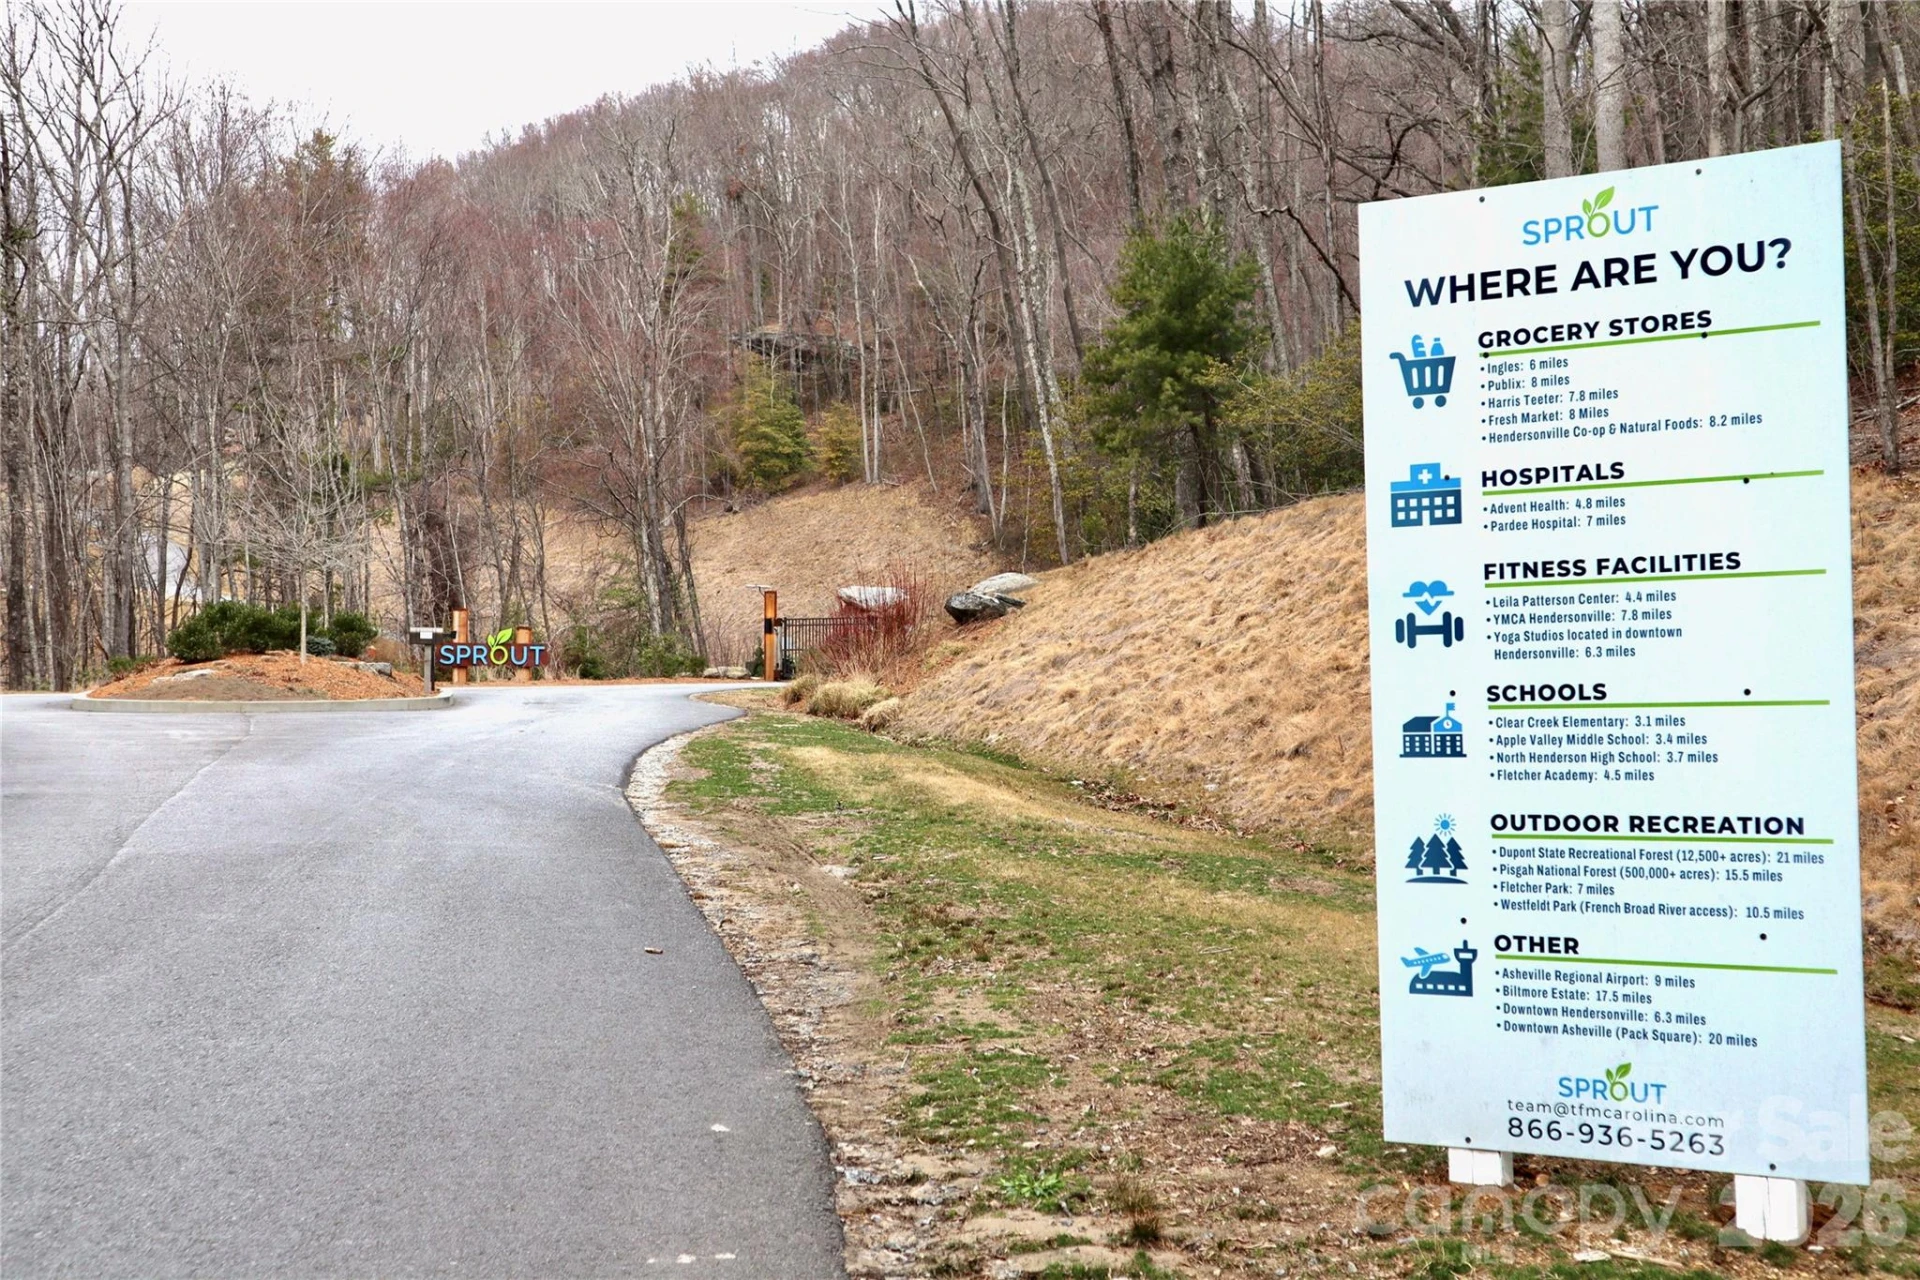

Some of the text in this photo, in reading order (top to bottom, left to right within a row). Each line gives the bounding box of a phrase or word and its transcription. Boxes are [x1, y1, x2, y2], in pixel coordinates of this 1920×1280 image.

[1522, 204, 1659, 246] SPROUT
[1403, 237, 1792, 308] WHERE ARE YOU?
[1477, 309, 1712, 349] GROCERY STORES
[1487, 356, 1569, 376] Ingles: 6 miles
[1487, 374, 1570, 391] Publix: 8 miles
[1487, 387, 1619, 409] Harris Teeter: 7.8 miles
[1488, 406, 1609, 426] Fresh Market: 8 Miles
[1488, 412, 1763, 444] Hendersonville Co-op & Natural Foods: 8.2 miles
[1481, 461, 1625, 488] HOSPITALS
[1489, 495, 1626, 515] Advent Health: 4.8 miles
[1490, 513, 1626, 532] Pardee Hospital: 7 miles
[1483, 551, 1741, 581] FITNESS FACILITIES
[1492, 589, 1677, 608] Leila Patterson Center: 4.4 miles
[1492, 607, 1672, 625] YMCA Hendersonville: 7.8 miles
[1493, 626, 1682, 645] Yoga Studios located in downtown
[440, 644, 545, 666] SPROUT
[1493, 644, 1636, 660] Hendersonville: 6.3 miles
[1486, 682, 1608, 703] SCHOOLS
[1495, 714, 1686, 730] Clear Creek Elementary: 3.1 miles
[1495, 732, 1707, 748] Apple Valley Middle School: 3.4 miles
[1496, 750, 1719, 766] North Henderson High School: 3.7 miles
[1496, 768, 1655, 784] Fletcher Academy: 4.5 miles
[1489, 813, 1805, 836] OUTDOOR RECREATION
[1499, 846, 1824, 865] Dupont State Recreational Forest (12,500+ acres): 21 miles
[1499, 863, 1783, 883] Pisgah National Forest (500,000+ acres): 15.5 miles
[1500, 880, 1615, 896] Fletcher Park: 7 miles
[1500, 898, 1805, 920] Westfeldt Park (French Broad River access): 10.5 miles
[1493, 933, 1580, 955] OTHER
[1501, 967, 1695, 989] Asheville Regional Airport: 9 miles
[1502, 984, 1652, 1005] Biltmore Estate: 17.5 miles
[1502, 1002, 1707, 1026] Downtown Hendersonville: 6.3 miles
[1503, 1019, 1758, 1048] Downtown Asheville (Pack Square): 20 miles
[1558, 1076, 1667, 1104] SPROUT
[1507, 1099, 1724, 1128] team@tfmcarolina.com
[1507, 1116, 1724, 1156] 866-936-5263
